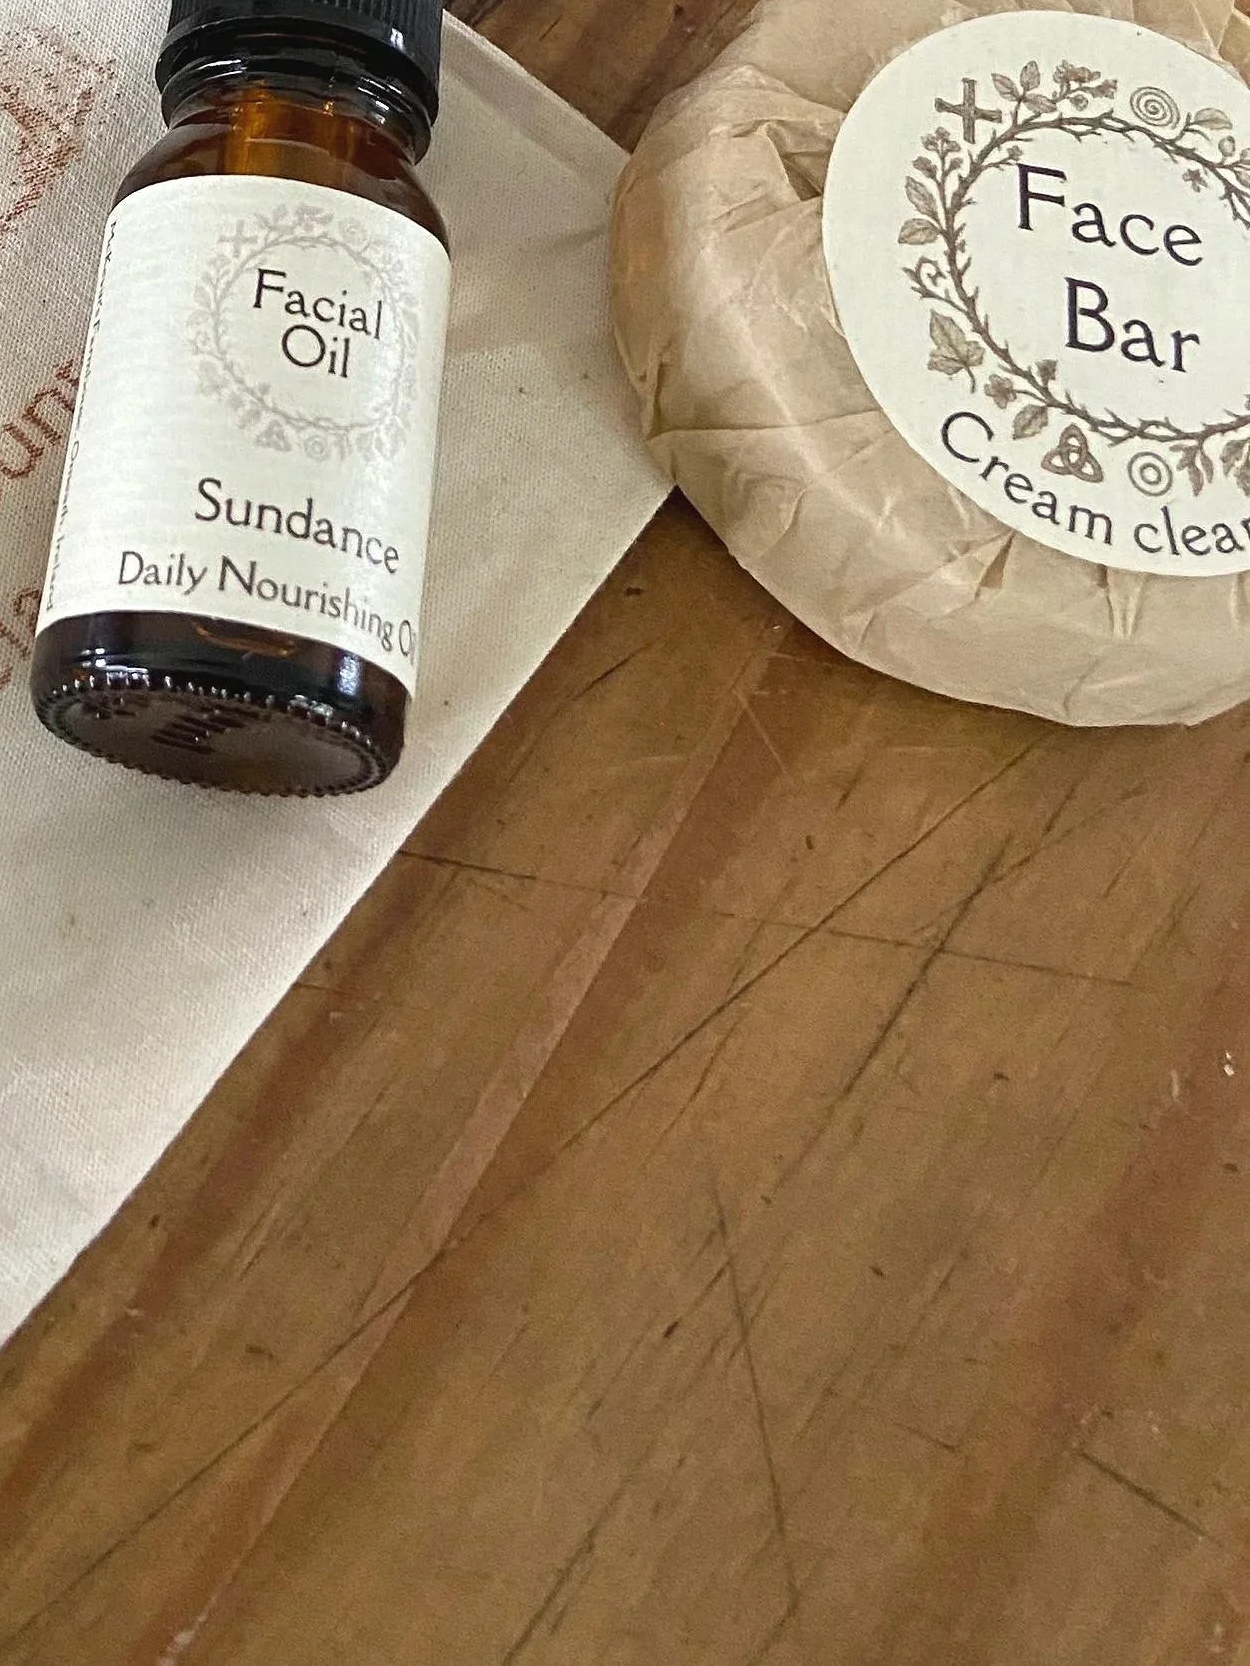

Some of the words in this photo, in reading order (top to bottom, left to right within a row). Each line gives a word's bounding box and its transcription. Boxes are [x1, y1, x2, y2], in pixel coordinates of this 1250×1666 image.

[1015, 162, 1205, 268] Face
[252, 267, 384, 342] Facial
[281, 323, 352, 380] Oil
[1064, 276, 1201, 375] Bar
[195, 477, 401, 575] Sundance
[939, 411, 1114, 547] Cream
[118, 549, 208, 596] Daily
[218, 555, 396, 652] Nourishing
